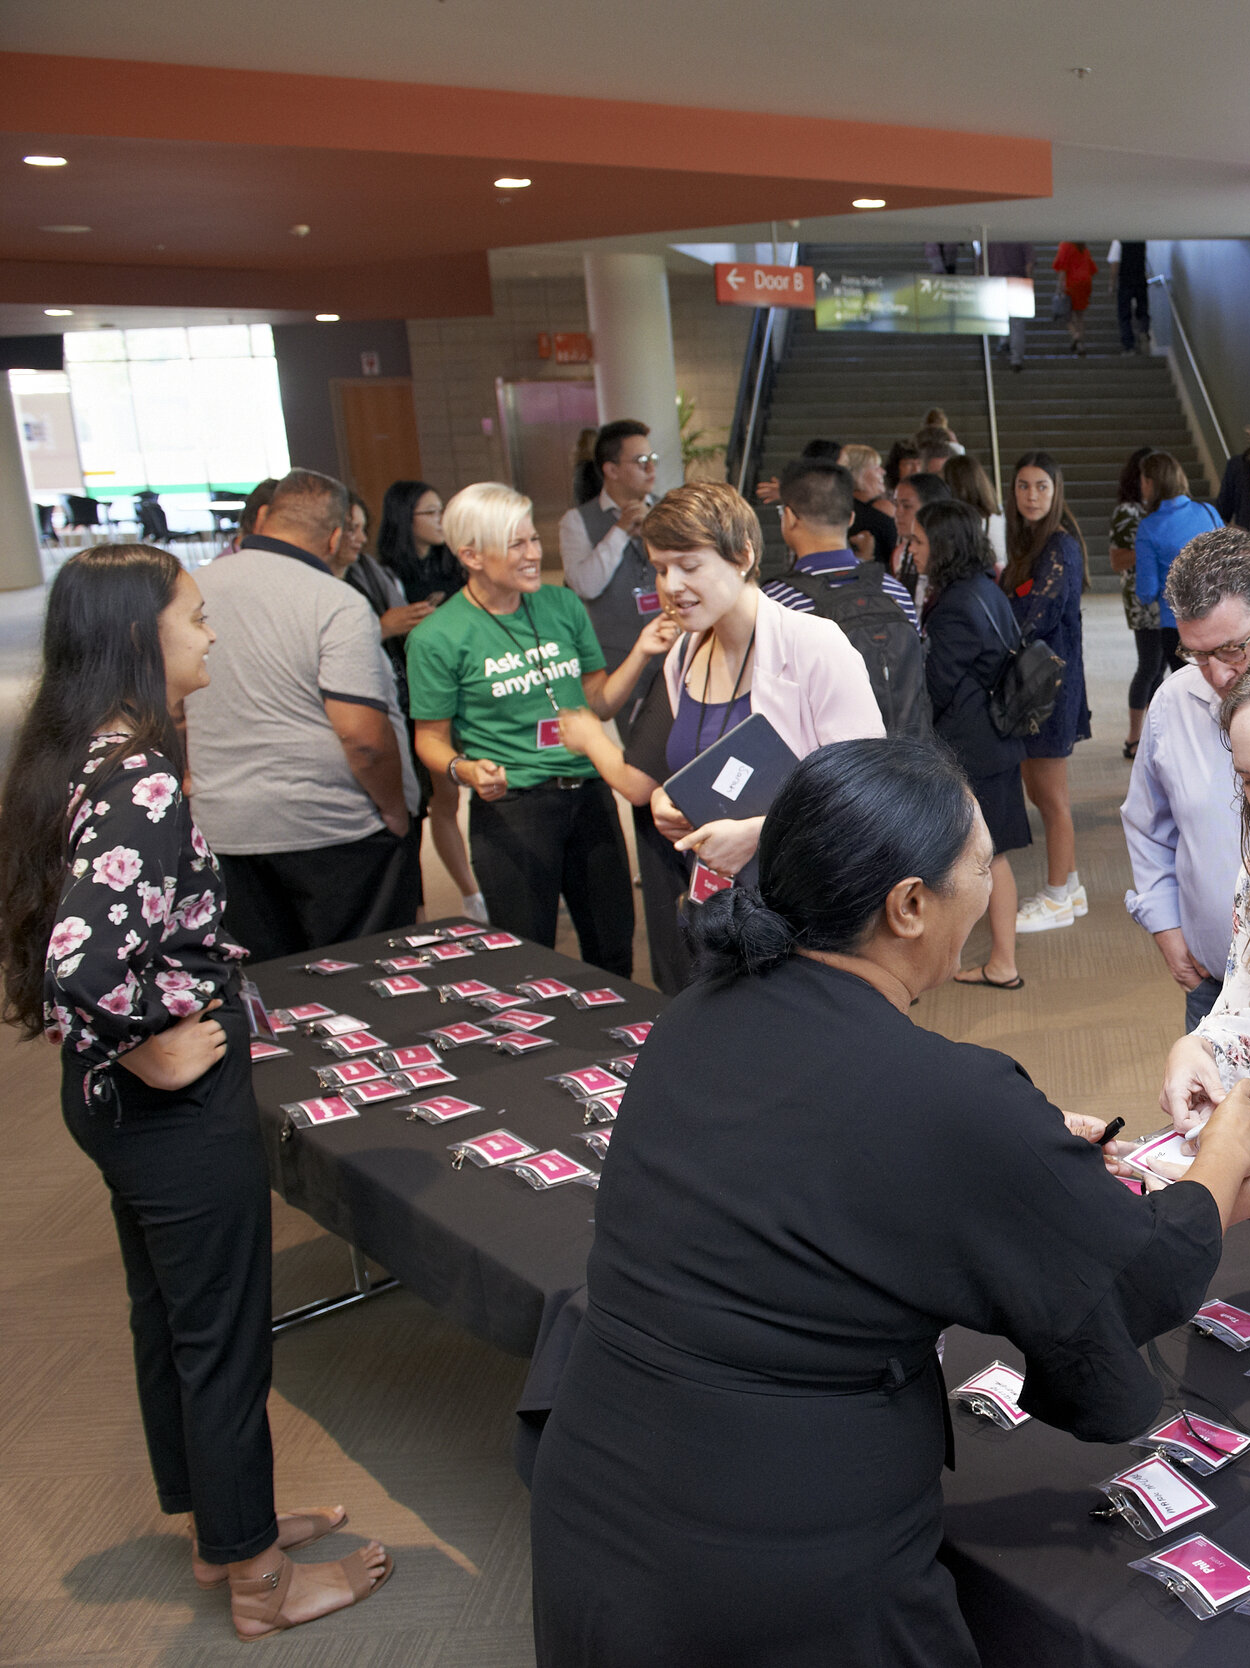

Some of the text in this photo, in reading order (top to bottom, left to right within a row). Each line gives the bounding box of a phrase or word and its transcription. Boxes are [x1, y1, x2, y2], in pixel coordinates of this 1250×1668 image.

[753, 270, 804, 292] Door B
[484, 641, 560, 678] Ask me
[491, 657, 581, 698] anything
[703, 879, 719, 892] Sarah
[1191, 1559, 1215, 1574] Phil
